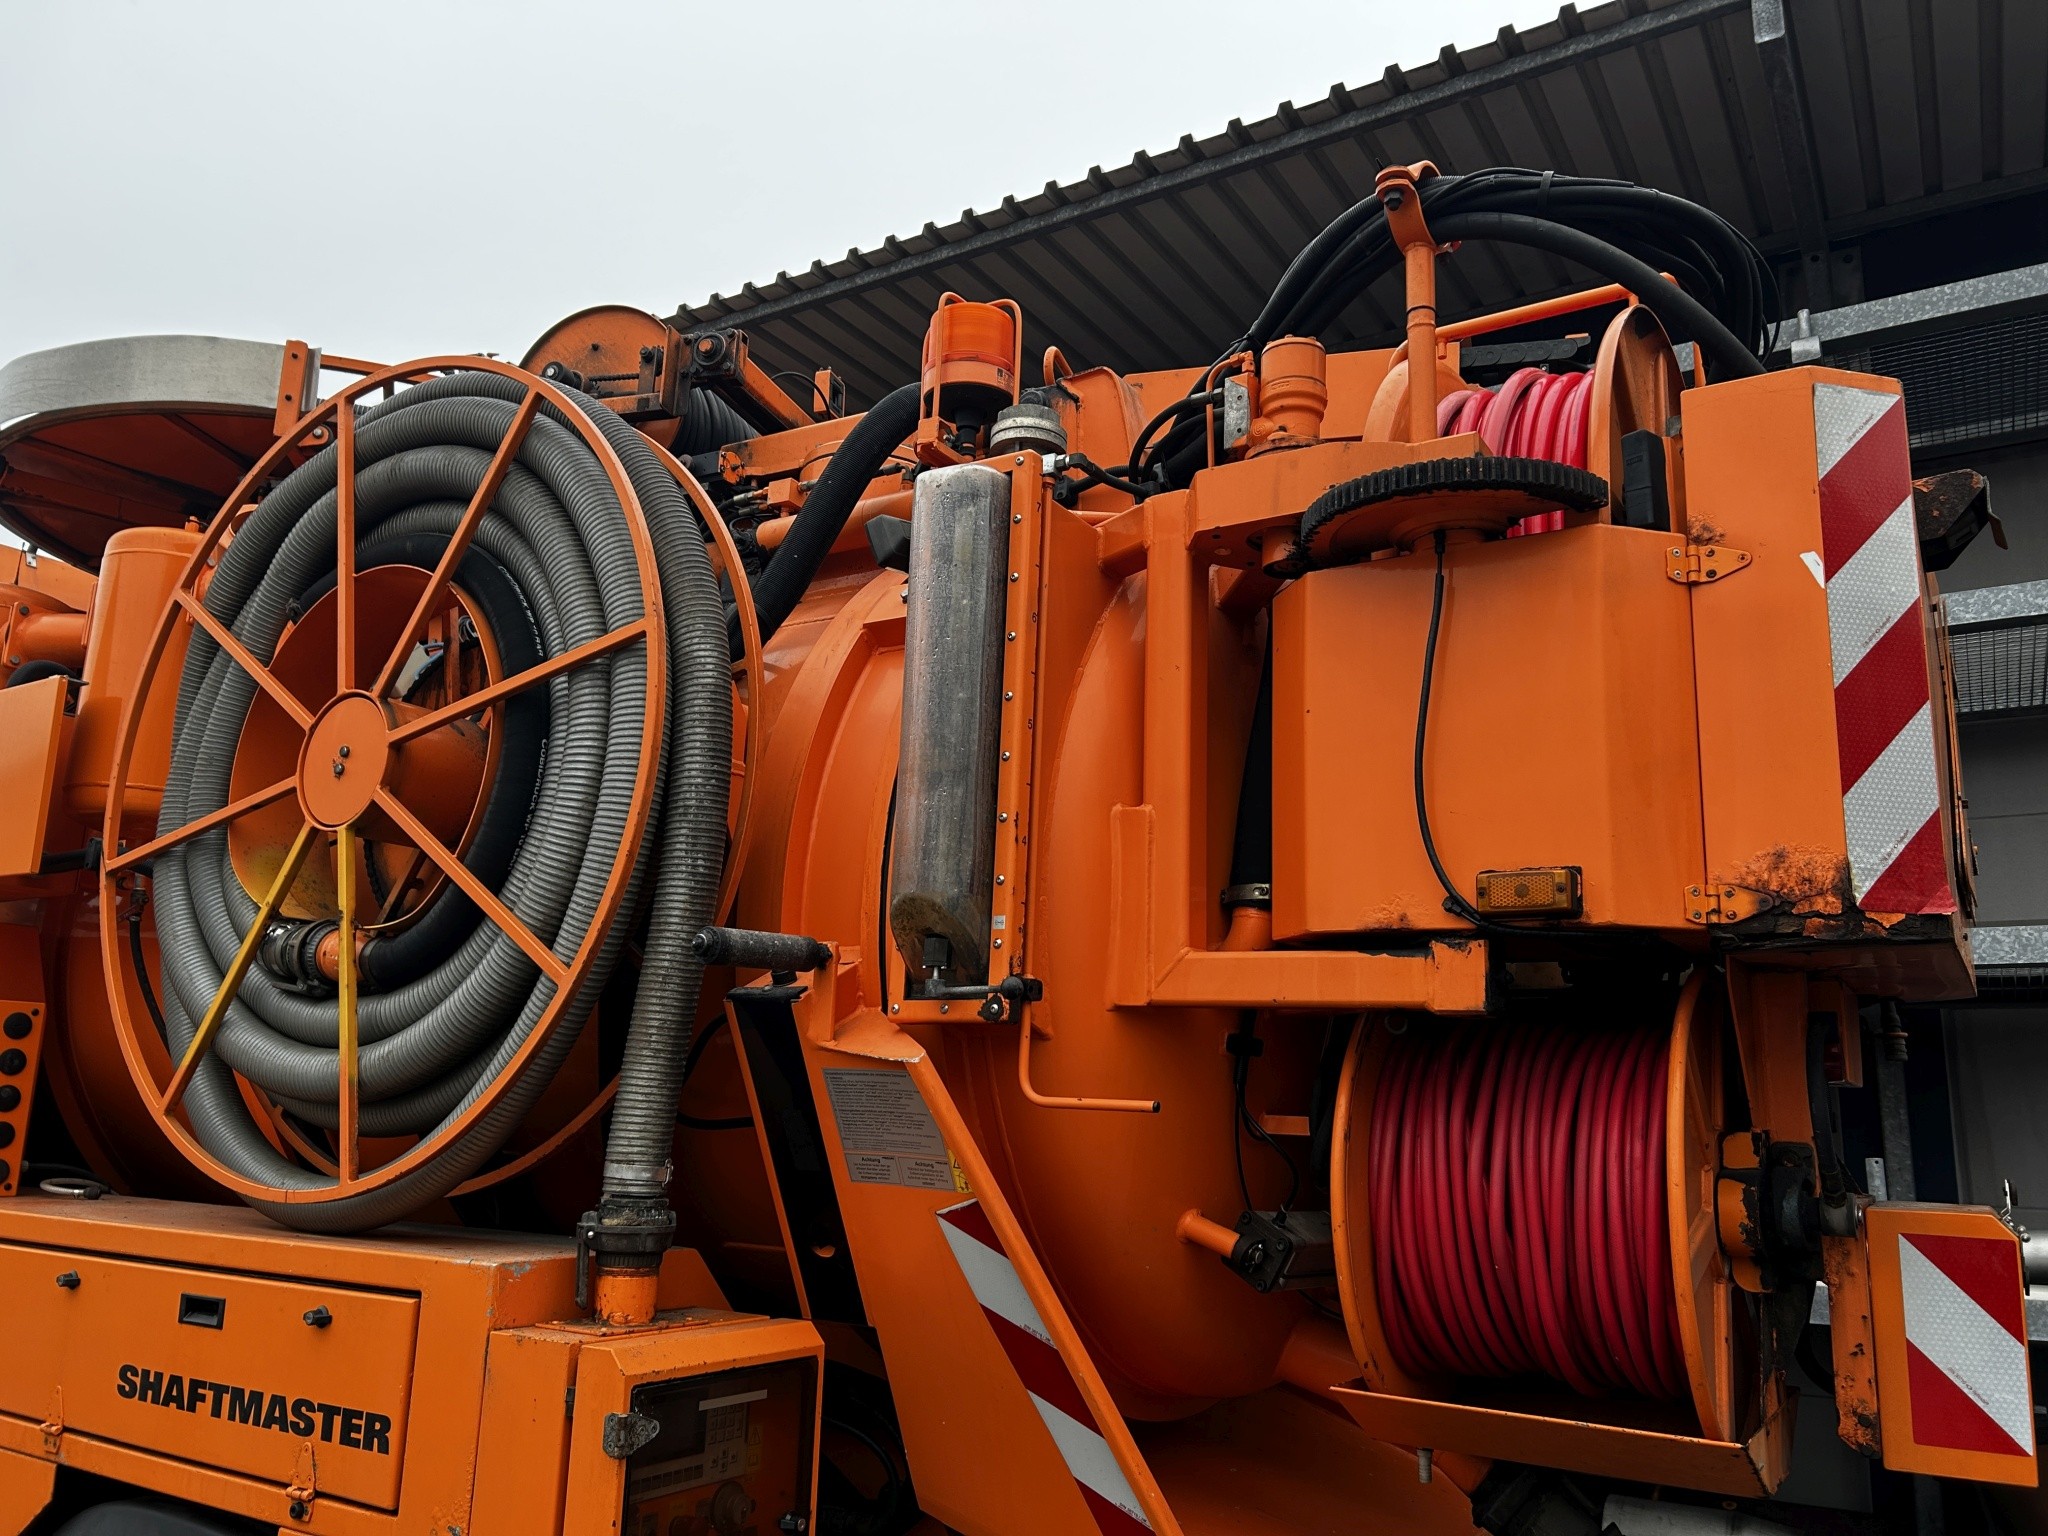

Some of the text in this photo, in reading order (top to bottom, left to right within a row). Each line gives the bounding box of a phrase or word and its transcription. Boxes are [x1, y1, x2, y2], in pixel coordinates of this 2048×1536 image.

[1031, 611, 1038, 624] 6
[1027, 718, 1033, 730] 5
[1021, 835, 1027, 847] 4
[862, 1156, 881, 1164] Achtung
[915, 1161, 935, 1169] Achtung
[116, 1363, 391, 1455] SHAFTMASTER
